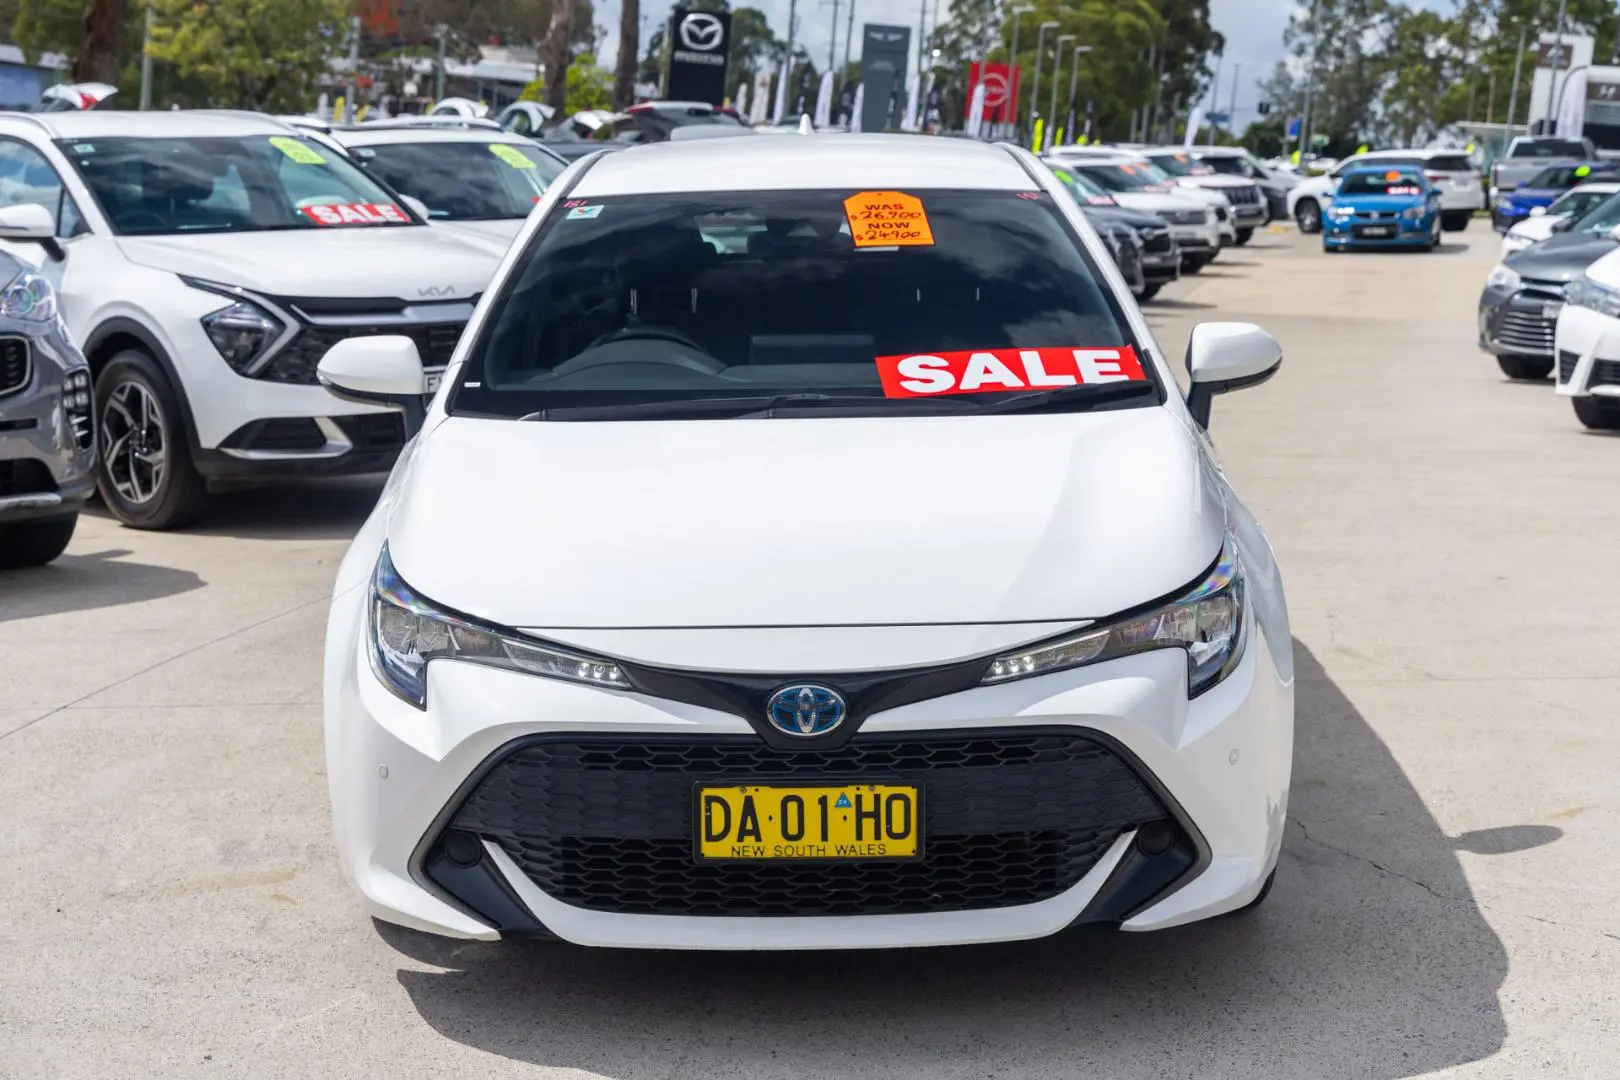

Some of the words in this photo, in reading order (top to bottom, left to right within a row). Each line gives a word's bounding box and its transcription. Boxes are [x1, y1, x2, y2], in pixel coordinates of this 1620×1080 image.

[310, 204, 406, 224] SALE
[897, 350, 1129, 394] SALE
[731, 845, 765, 857] NEW
[774, 844, 826, 857] SOUTH
[835, 843, 887, 856] WALES
